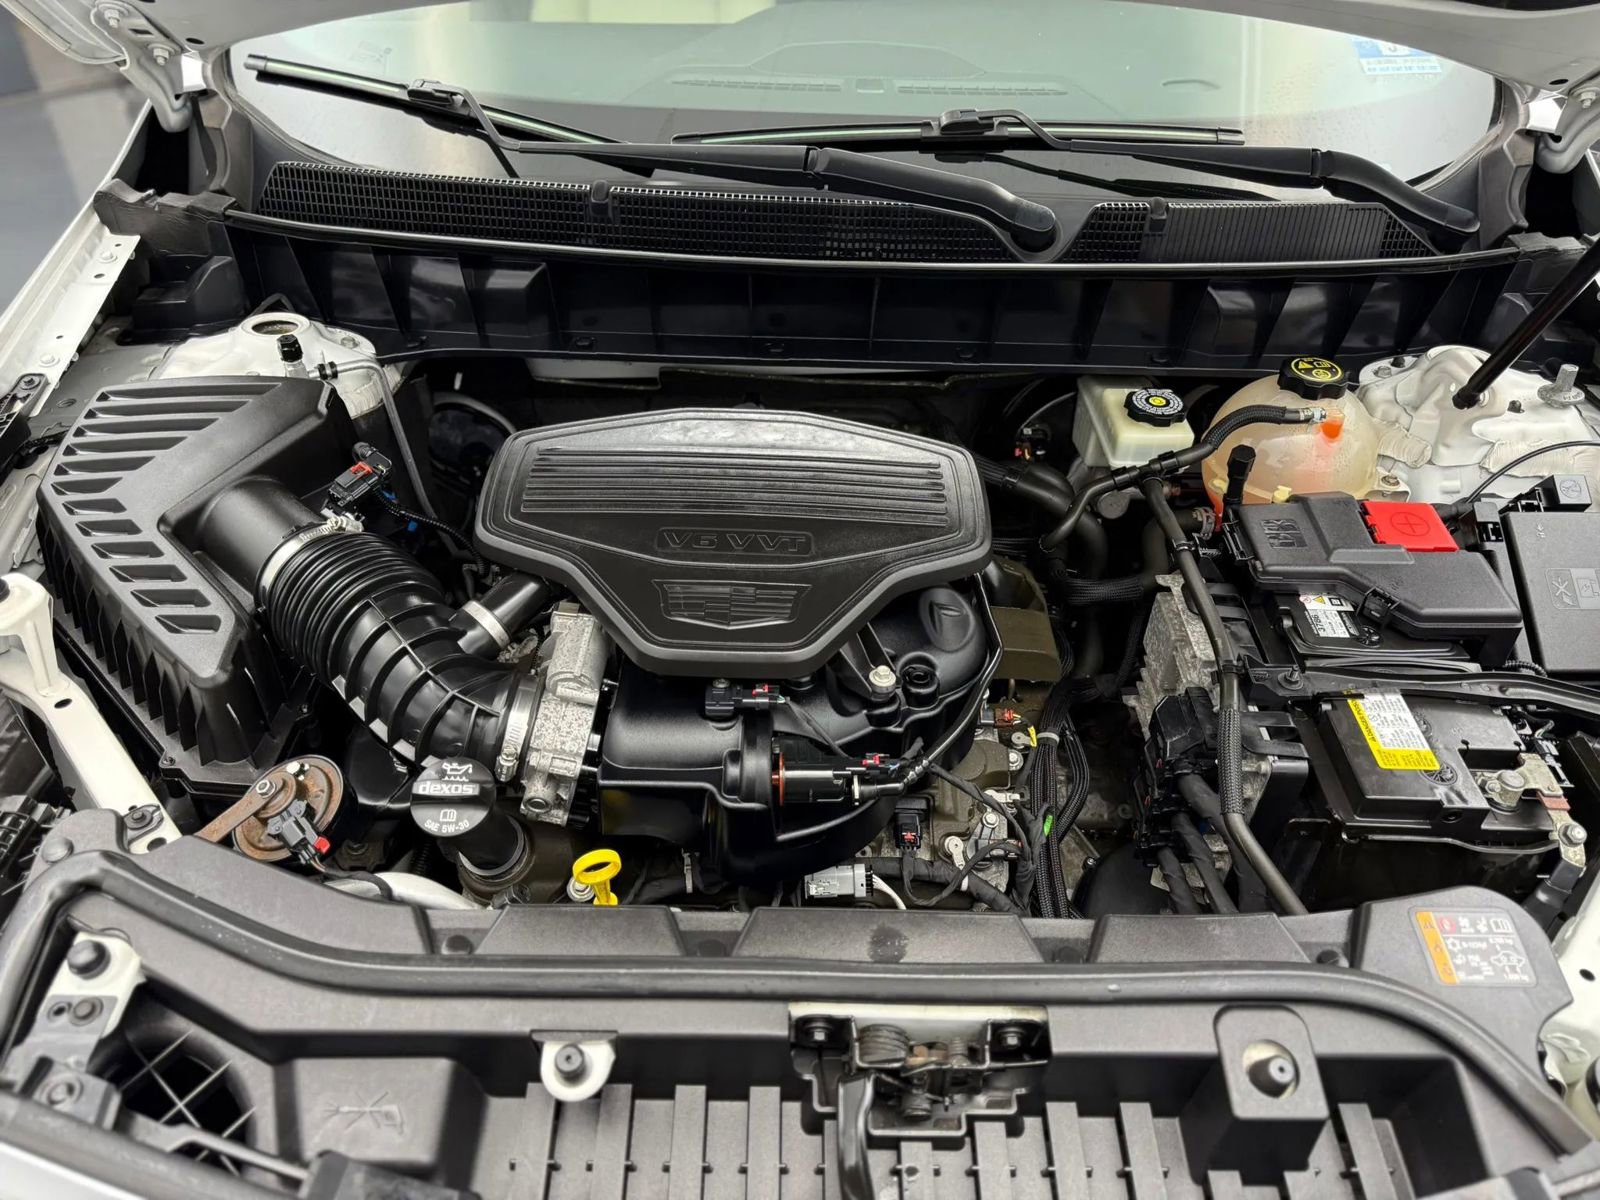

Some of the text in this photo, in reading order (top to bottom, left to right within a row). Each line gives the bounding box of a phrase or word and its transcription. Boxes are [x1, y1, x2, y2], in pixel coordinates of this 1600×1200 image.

[664, 532, 806, 551] V6 VVT
[419, 780, 476, 794] dexos
[424, 819, 470, 833] SAE 5W-30
